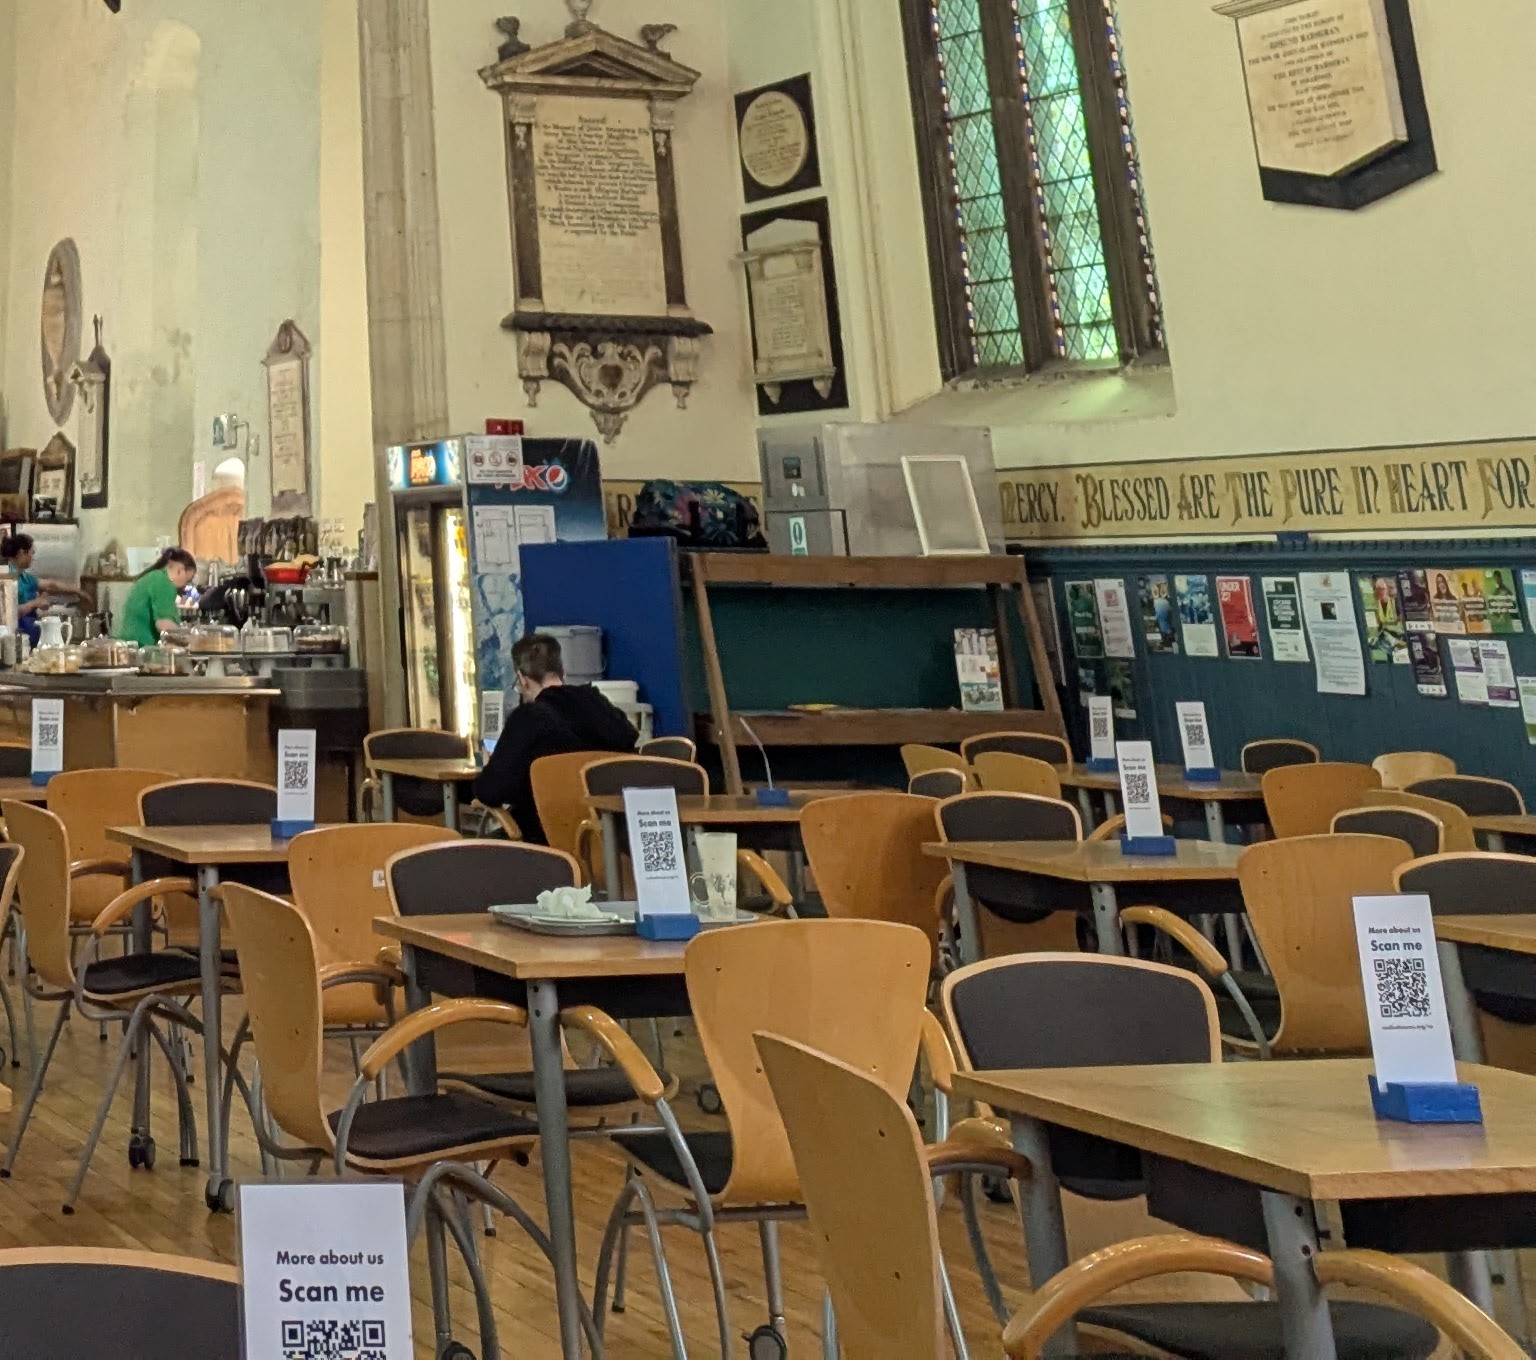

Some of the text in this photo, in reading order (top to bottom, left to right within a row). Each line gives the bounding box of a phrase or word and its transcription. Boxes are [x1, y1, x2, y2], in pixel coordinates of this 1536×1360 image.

[1075, 471, 1171, 530] BLESSED
[1177, 472, 1221, 522] ARE
[1224, 470, 1274, 527] THE
[1279, 466, 1345, 526] PURE
[1350, 464, 1382, 516] IN
[1383, 459, 1469, 515] HEART
[1476, 456, 1536, 521] FOR
[638, 819, 658, 828] Scan
[1368, 926, 1388, 934] More
[1389, 925, 1411, 934] about
[1370, 940, 1423, 952] Scan me
[276, 1249, 385, 1265] More about us
[279, 1278, 385, 1303] Scan me
